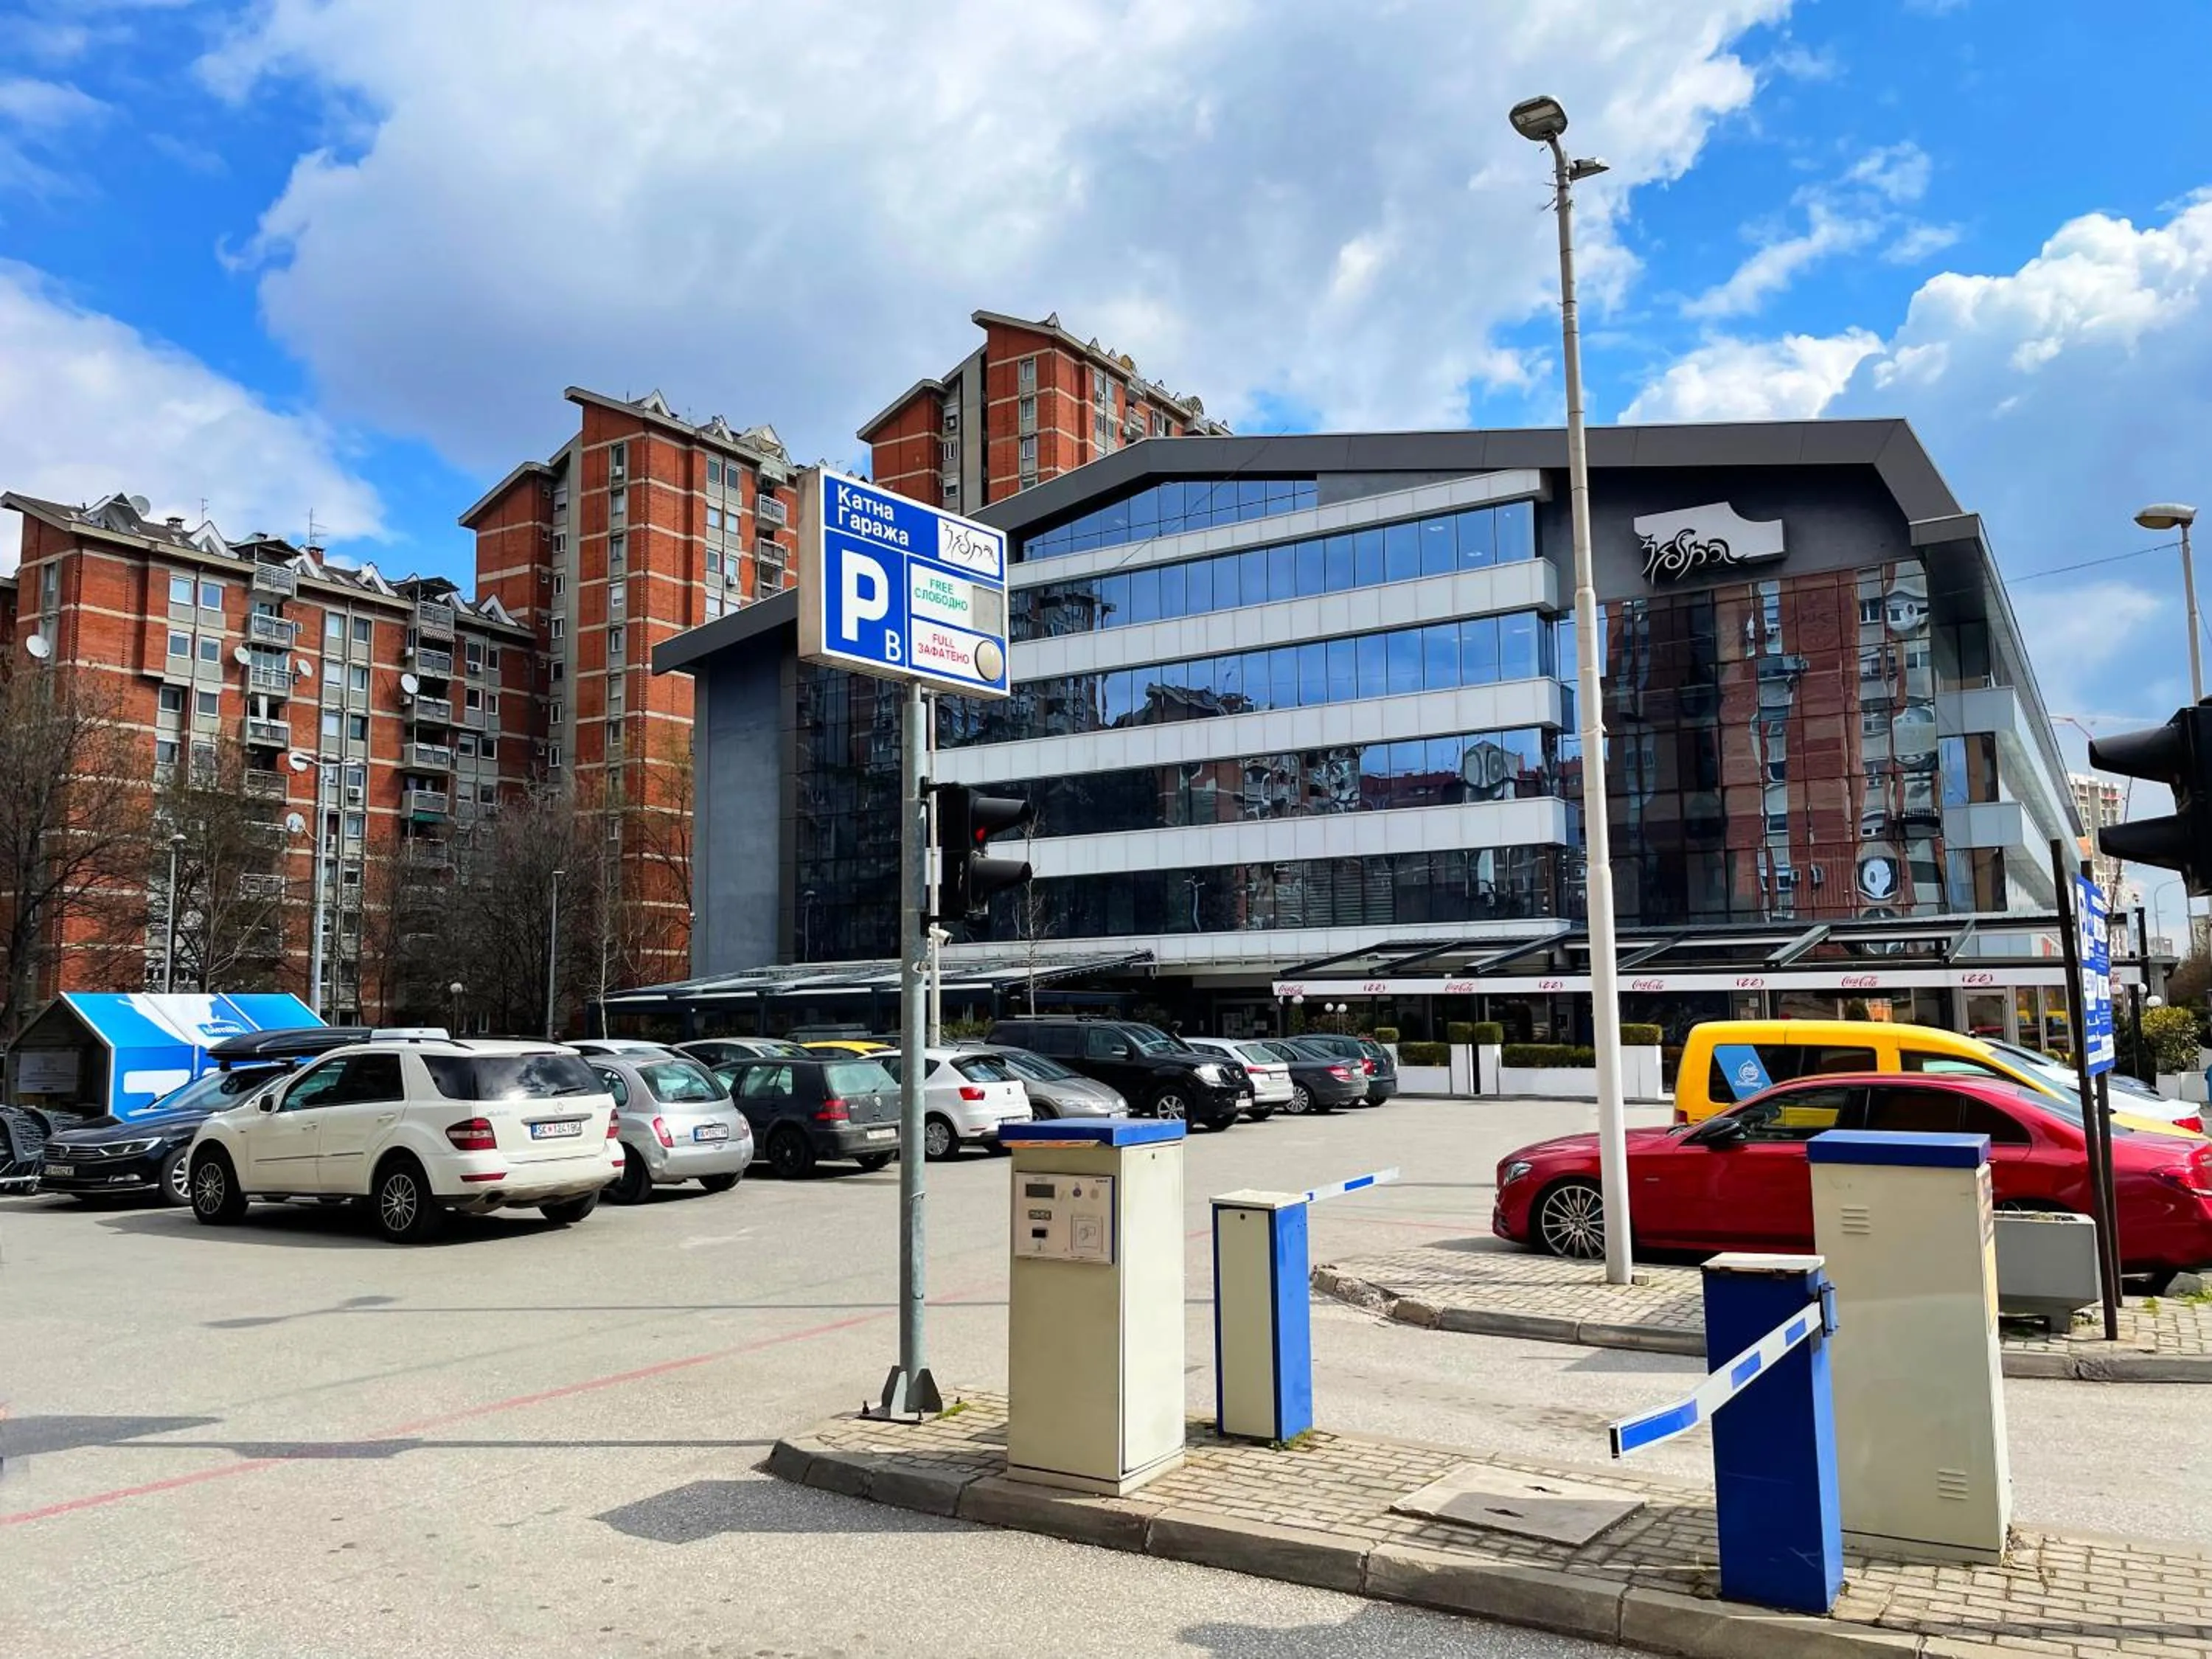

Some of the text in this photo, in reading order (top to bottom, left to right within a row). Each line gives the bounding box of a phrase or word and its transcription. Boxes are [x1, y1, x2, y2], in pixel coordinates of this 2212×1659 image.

[837, 484, 894, 522] Катна
[838, 506, 909, 547] Гаража
[841, 549, 889, 642] P
[930, 577, 954, 595] FREE
[914, 588, 968, 612] СЛОБОДНО
[918, 642, 970, 665] ЗАФАТЕНО
[933, 633, 955, 650] FULL
